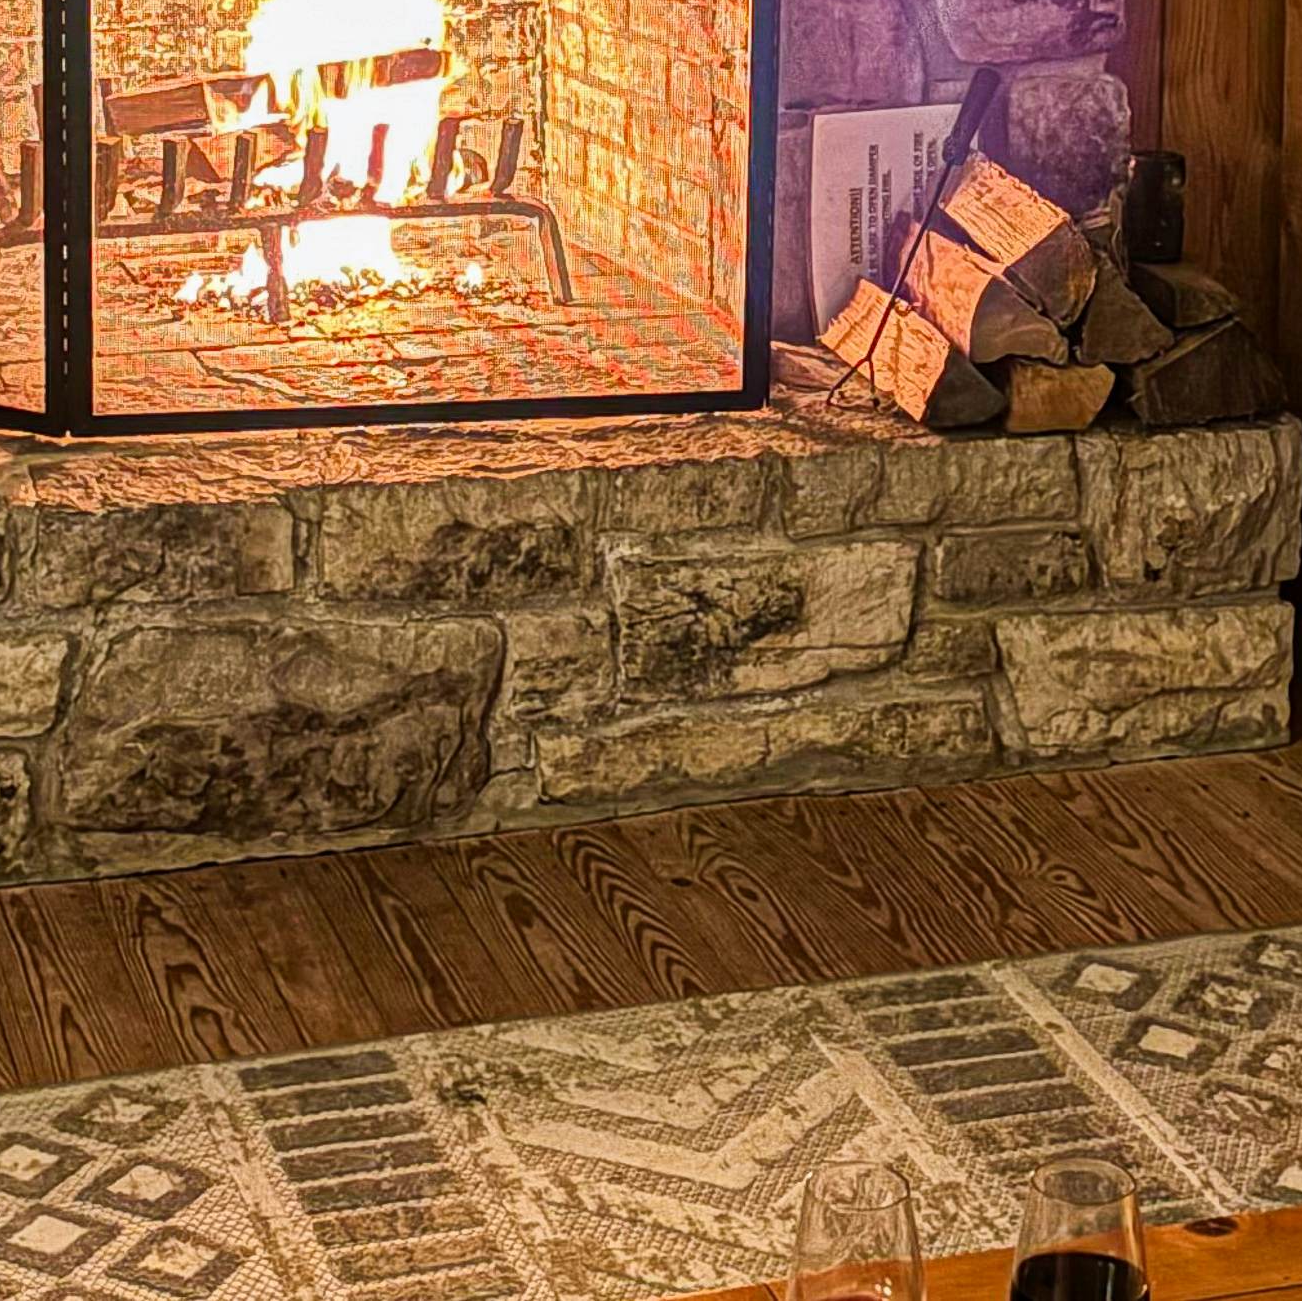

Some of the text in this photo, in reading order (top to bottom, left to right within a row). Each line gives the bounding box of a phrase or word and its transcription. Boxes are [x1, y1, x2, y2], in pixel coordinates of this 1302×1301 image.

[868, 145, 879, 185] DAMPER
[867, 186, 879, 215] OPEN
[868, 215, 879, 229] TO
